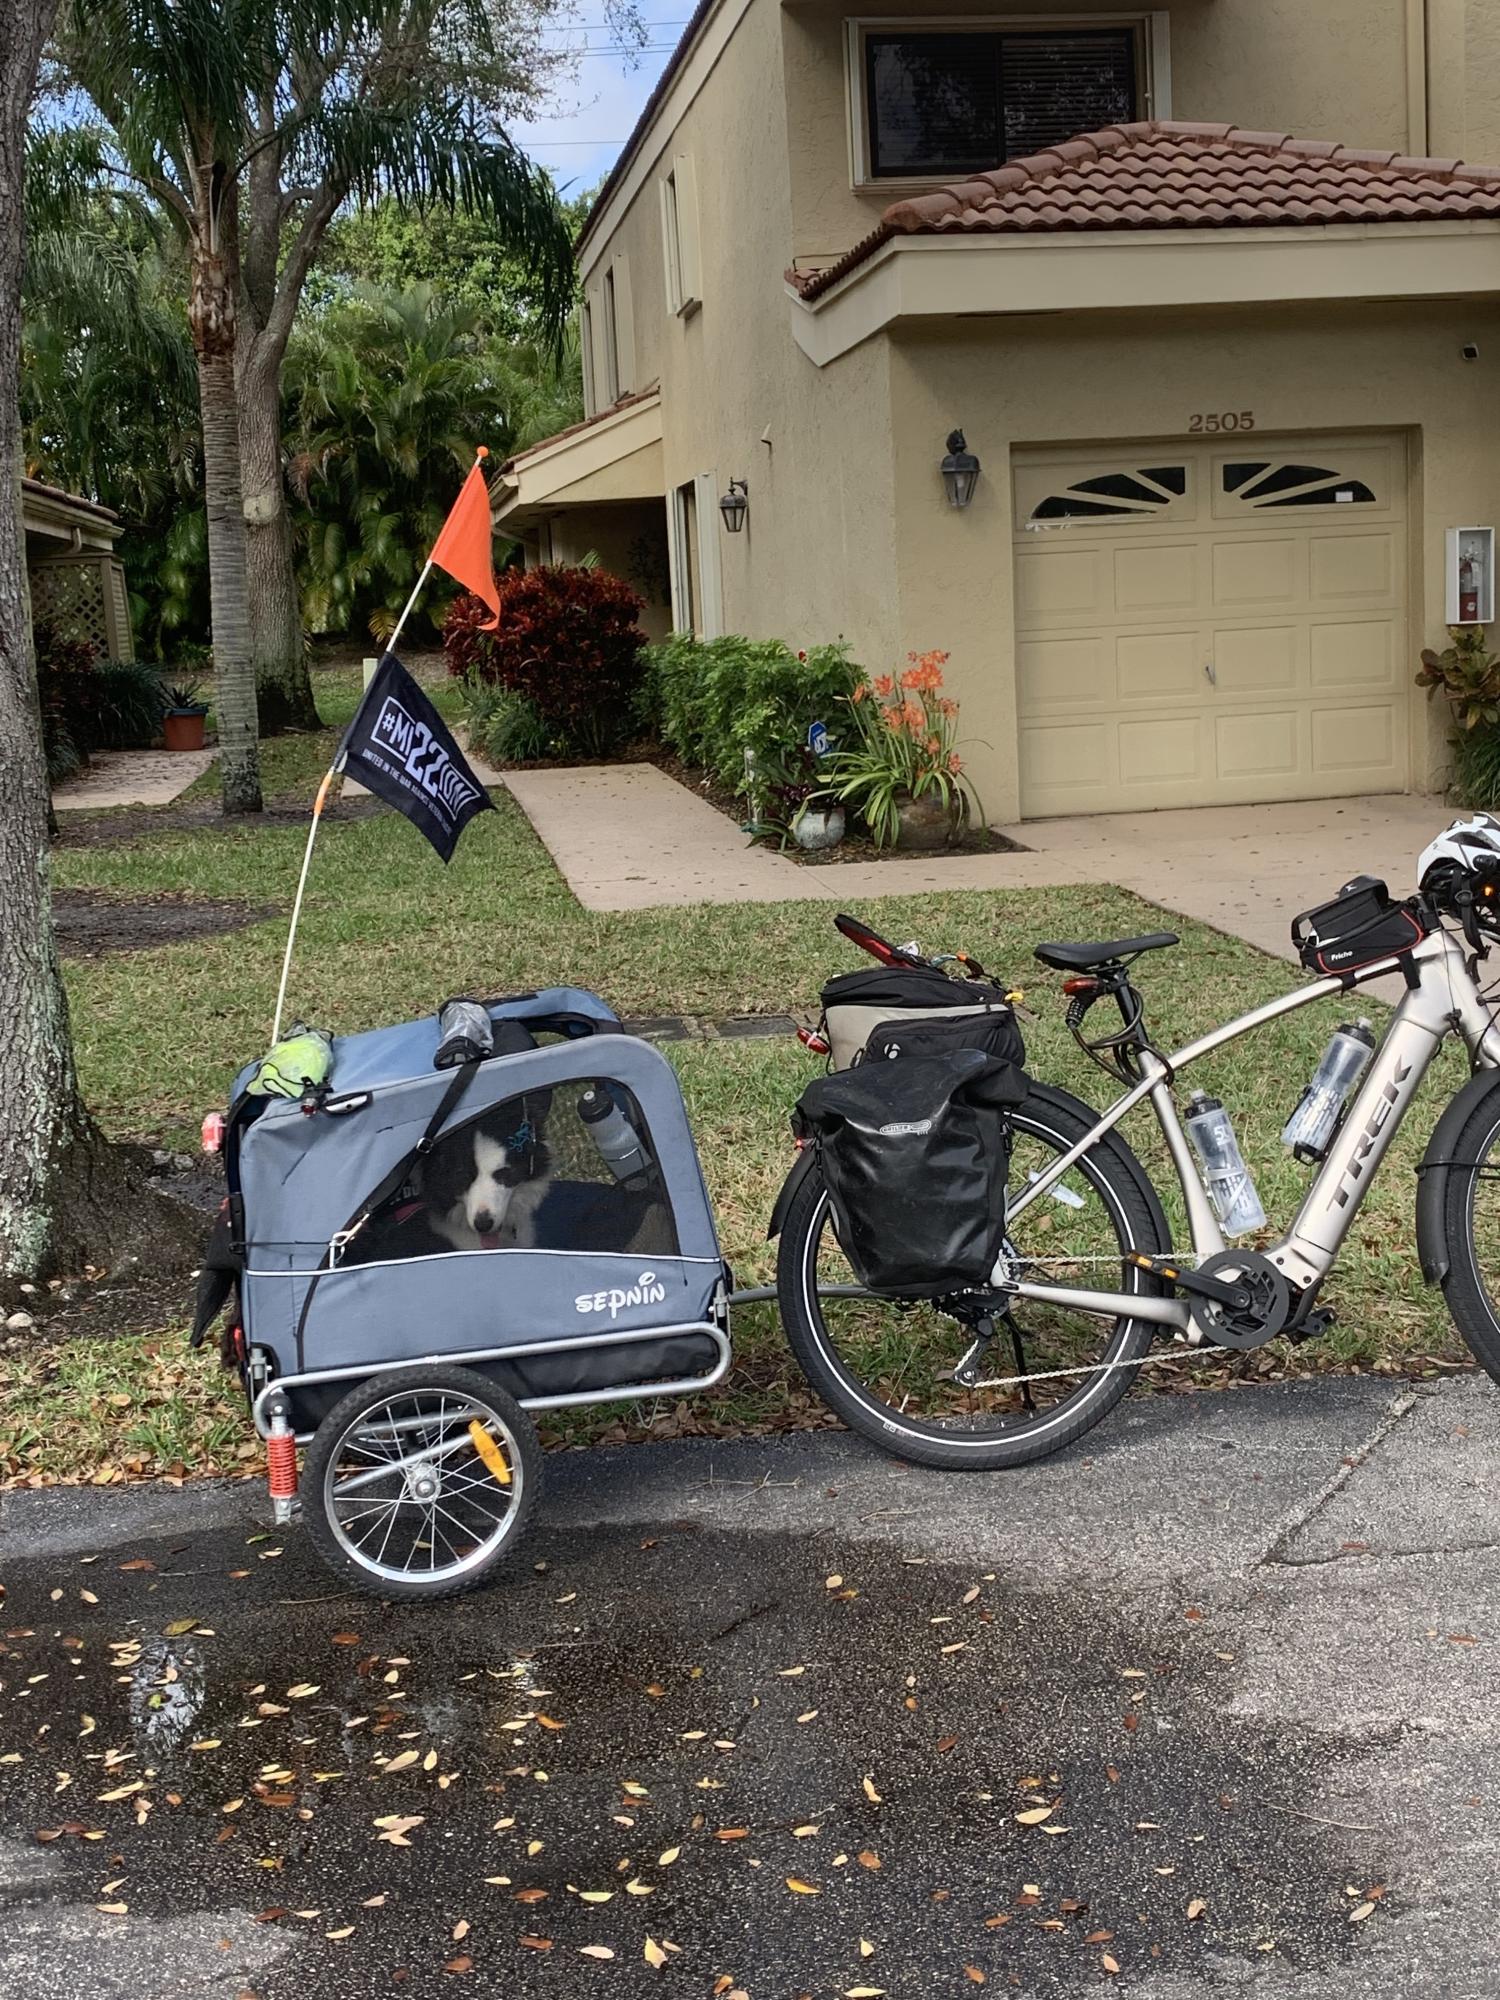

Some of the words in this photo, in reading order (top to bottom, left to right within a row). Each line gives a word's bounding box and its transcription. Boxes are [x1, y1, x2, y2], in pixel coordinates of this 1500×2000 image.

[1188, 410, 1255, 433] 2505
[362, 748, 384, 768] UNITED
[1326, 1054, 1413, 1212] TREK
[574, 1271, 665, 1319] SEPNIN
